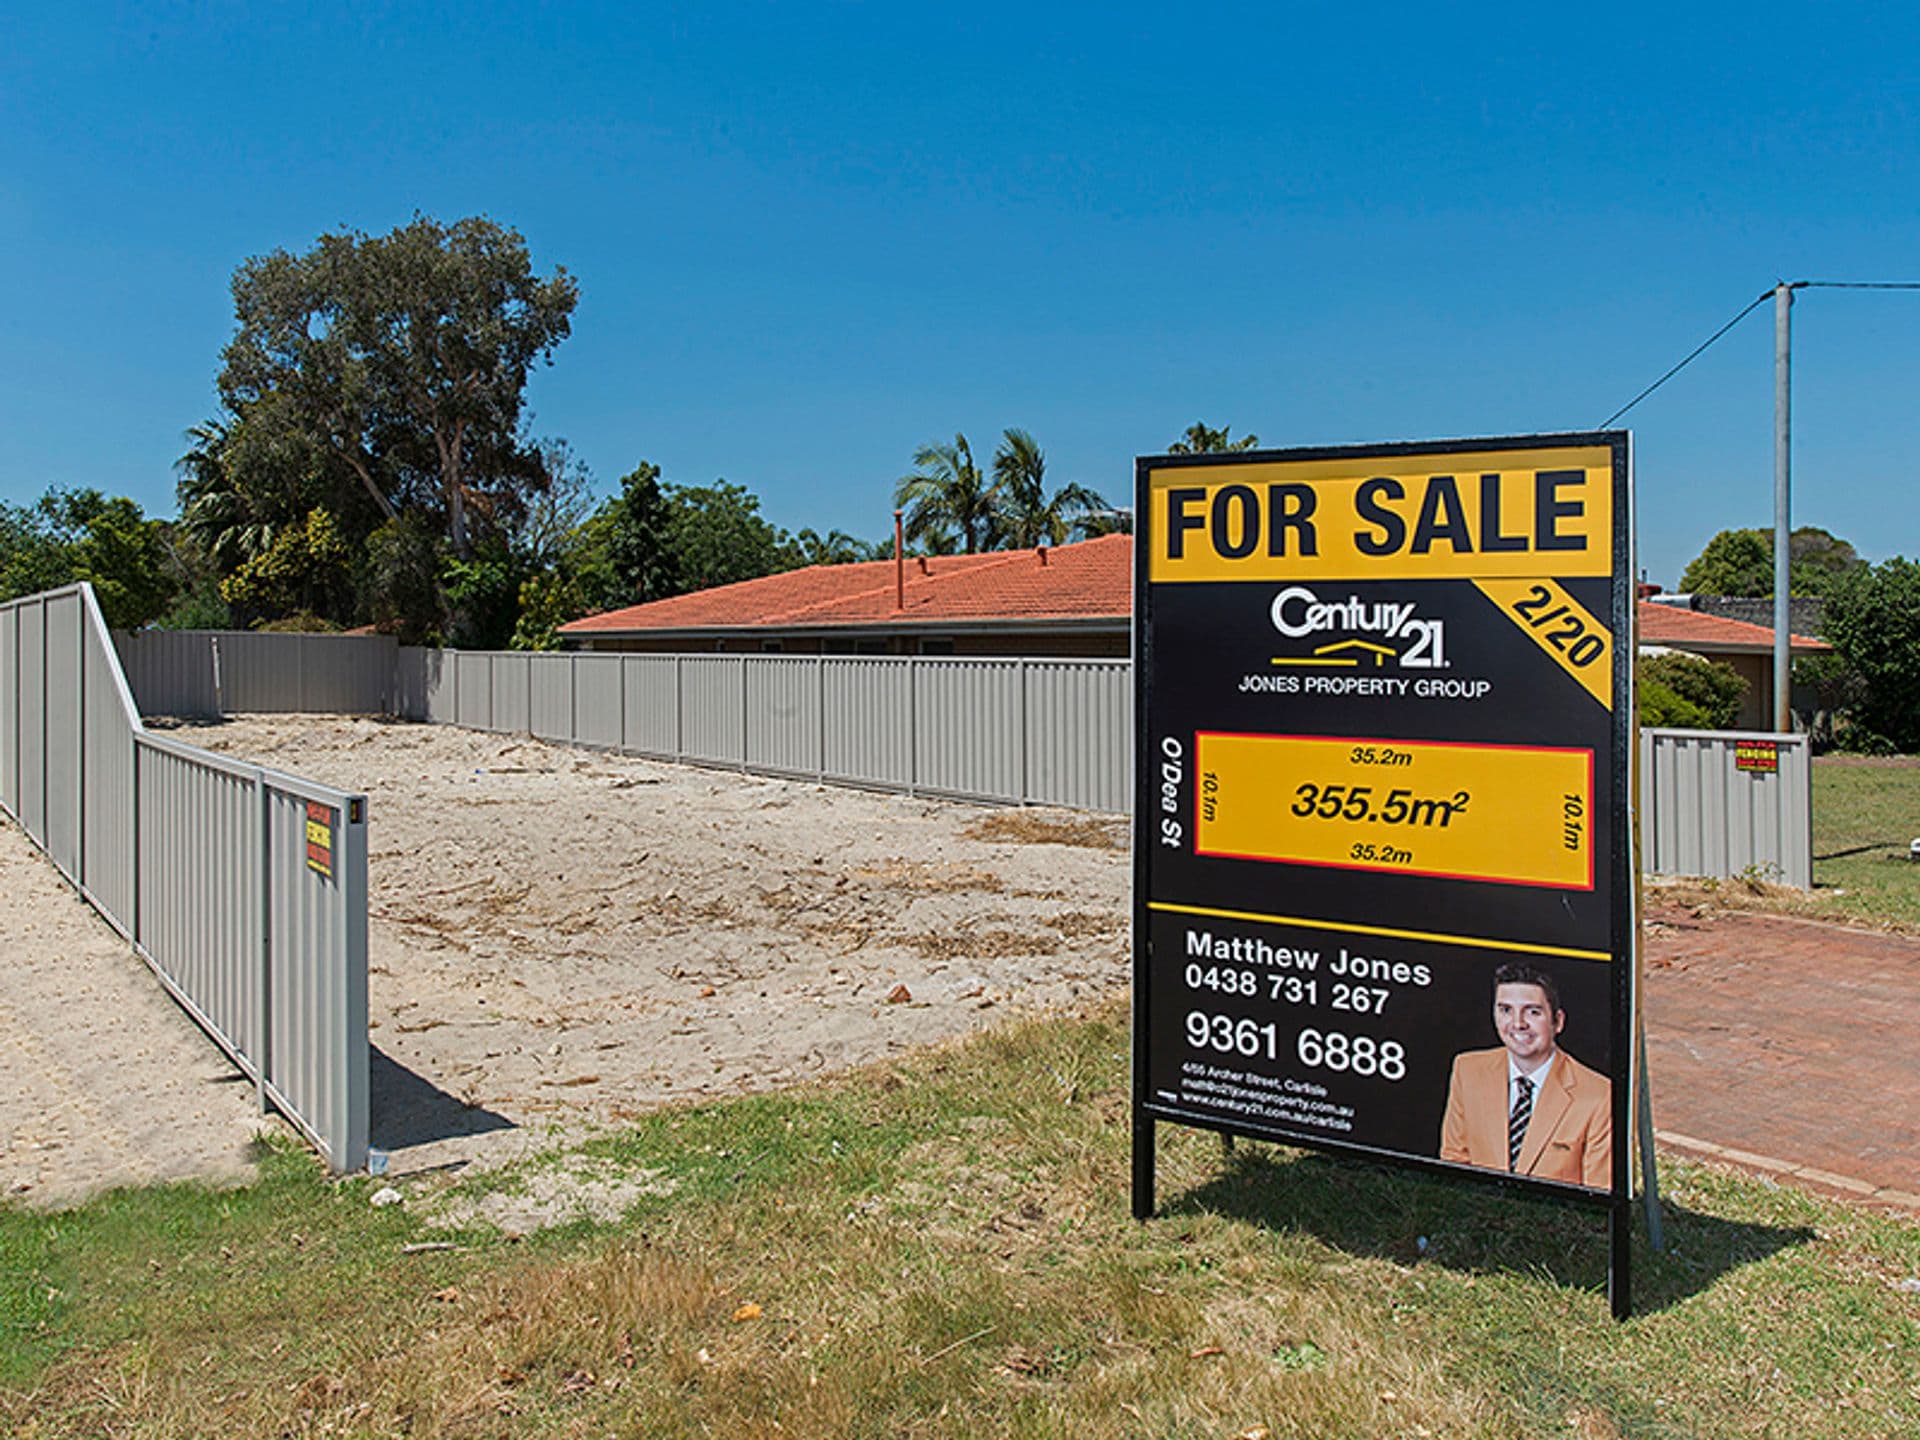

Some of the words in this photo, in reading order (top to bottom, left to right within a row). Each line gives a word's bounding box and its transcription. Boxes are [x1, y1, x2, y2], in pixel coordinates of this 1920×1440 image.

[1165, 482, 1319, 560] FOR
[1352, 469, 1588, 557] SALE
[1271, 587, 1417, 639] Century
[1511, 583, 1605, 669] 2/20
[1238, 674, 1300, 693] JONES
[1304, 676, 1410, 696] PROPERTY
[1413, 679, 1491, 698] GROUP
[1161, 737, 1183, 813] O'Dea
[1349, 745, 1413, 768] 35.2m
[1202, 771, 1220, 823] 10.1m
[1563, 793, 1584, 852] 10.1m
[1161, 818, 1182, 848] St
[1349, 842, 1413, 865] 35.2m
[1185, 931, 1320, 971] Matthew
[1329, 949, 1431, 986] Jones
[1185, 963, 1257, 996] 0438
[1267, 974, 1317, 1005] 731
[1331, 983, 1389, 1014] 267
[1186, 1011, 1276, 1060] 9361
[1298, 1028, 1406, 1080] 6888
[1207, 1066, 1244, 1082] Archer
